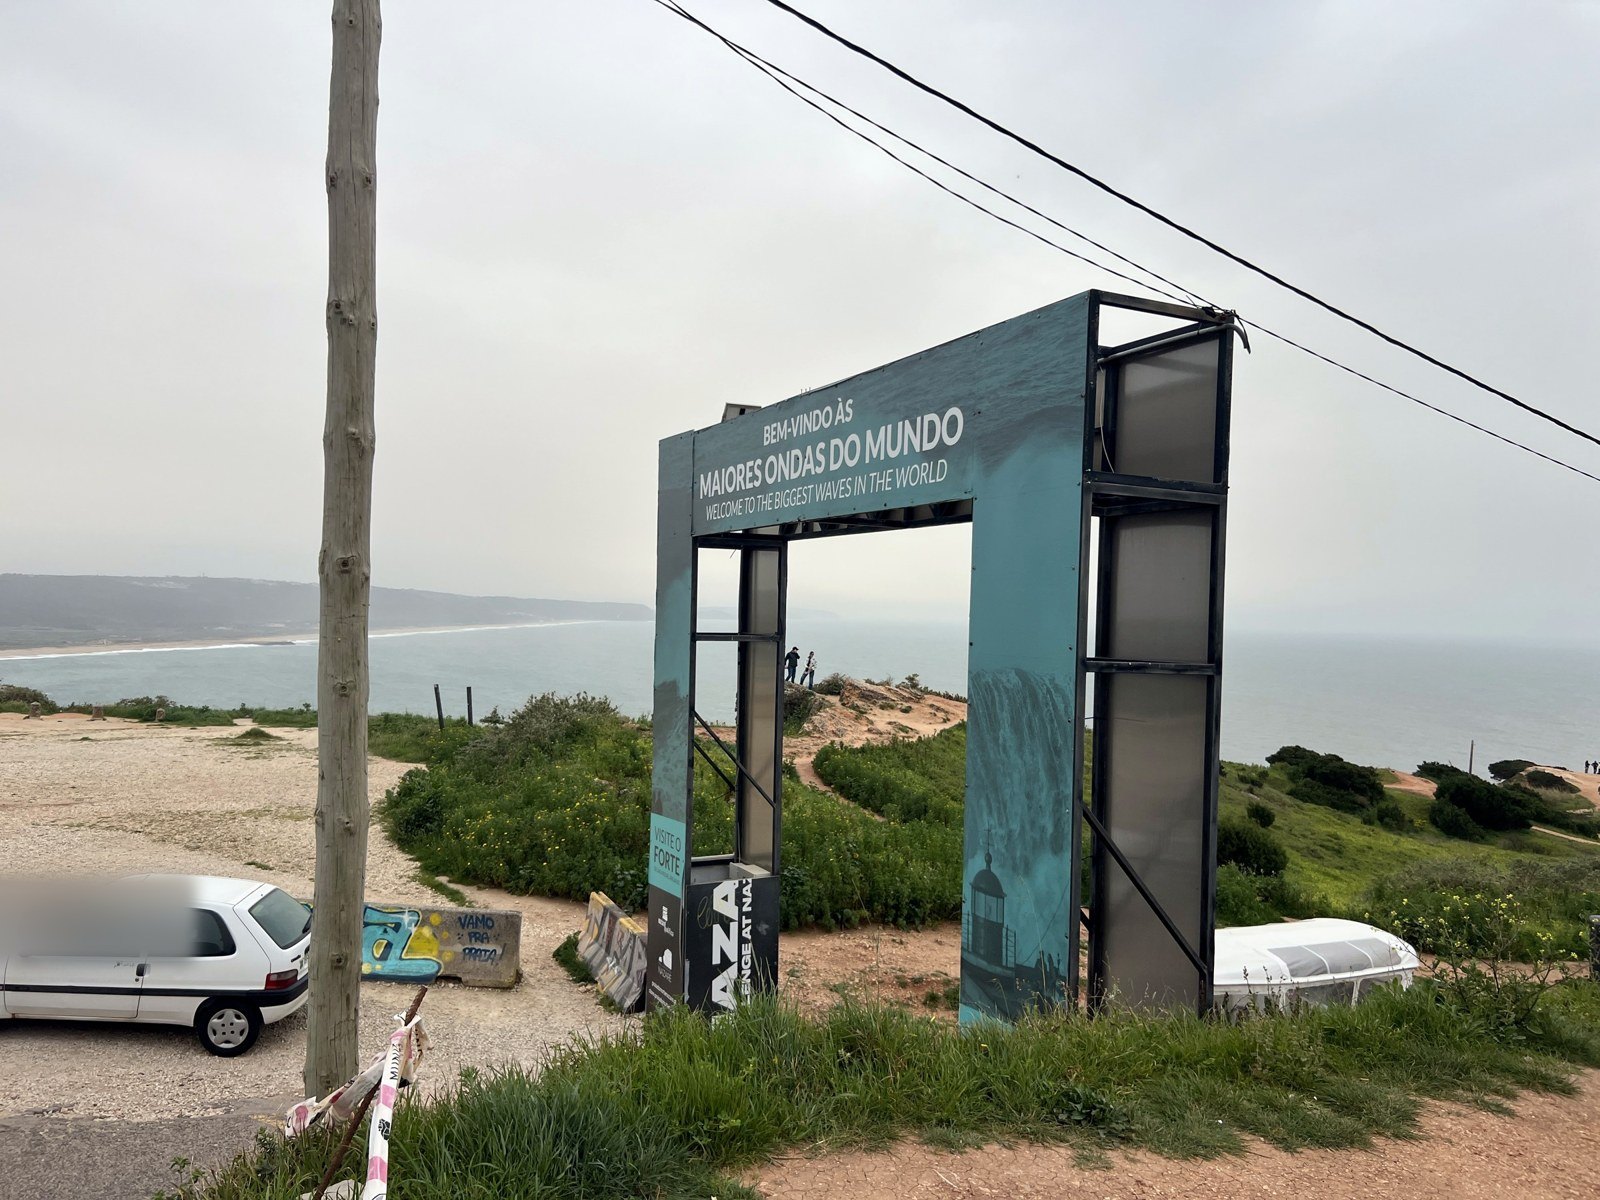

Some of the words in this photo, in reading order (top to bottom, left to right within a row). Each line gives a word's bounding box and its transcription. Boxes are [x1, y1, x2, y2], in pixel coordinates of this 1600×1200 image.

[763, 405, 833, 446] BEM-VINDO
[834, 397, 854, 426] ÀS
[700, 458, 762, 499] MAIORES
[765, 441, 826, 485] ONDAS
[829, 433, 861, 471] DO
[865, 406, 964, 464] MUNDO
[705, 498, 743, 521] WELCOME
[744, 496, 756, 514] TO
[756, 492, 774, 512] THE
[774, 484, 814, 510] BIGGEST
[815, 477, 852, 502] WAVES
[853, 474, 867, 496] IN
[869, 469, 894, 493] THE
[895, 459, 948, 489] WORLD
[654, 826, 675, 850] VISITE
[675, 837, 682, 852] O
[654, 845, 681, 876] FORTE
[458, 914, 494, 929] VAMO
[741, 915, 752, 940] AT
[468, 931, 490, 944] PRA
